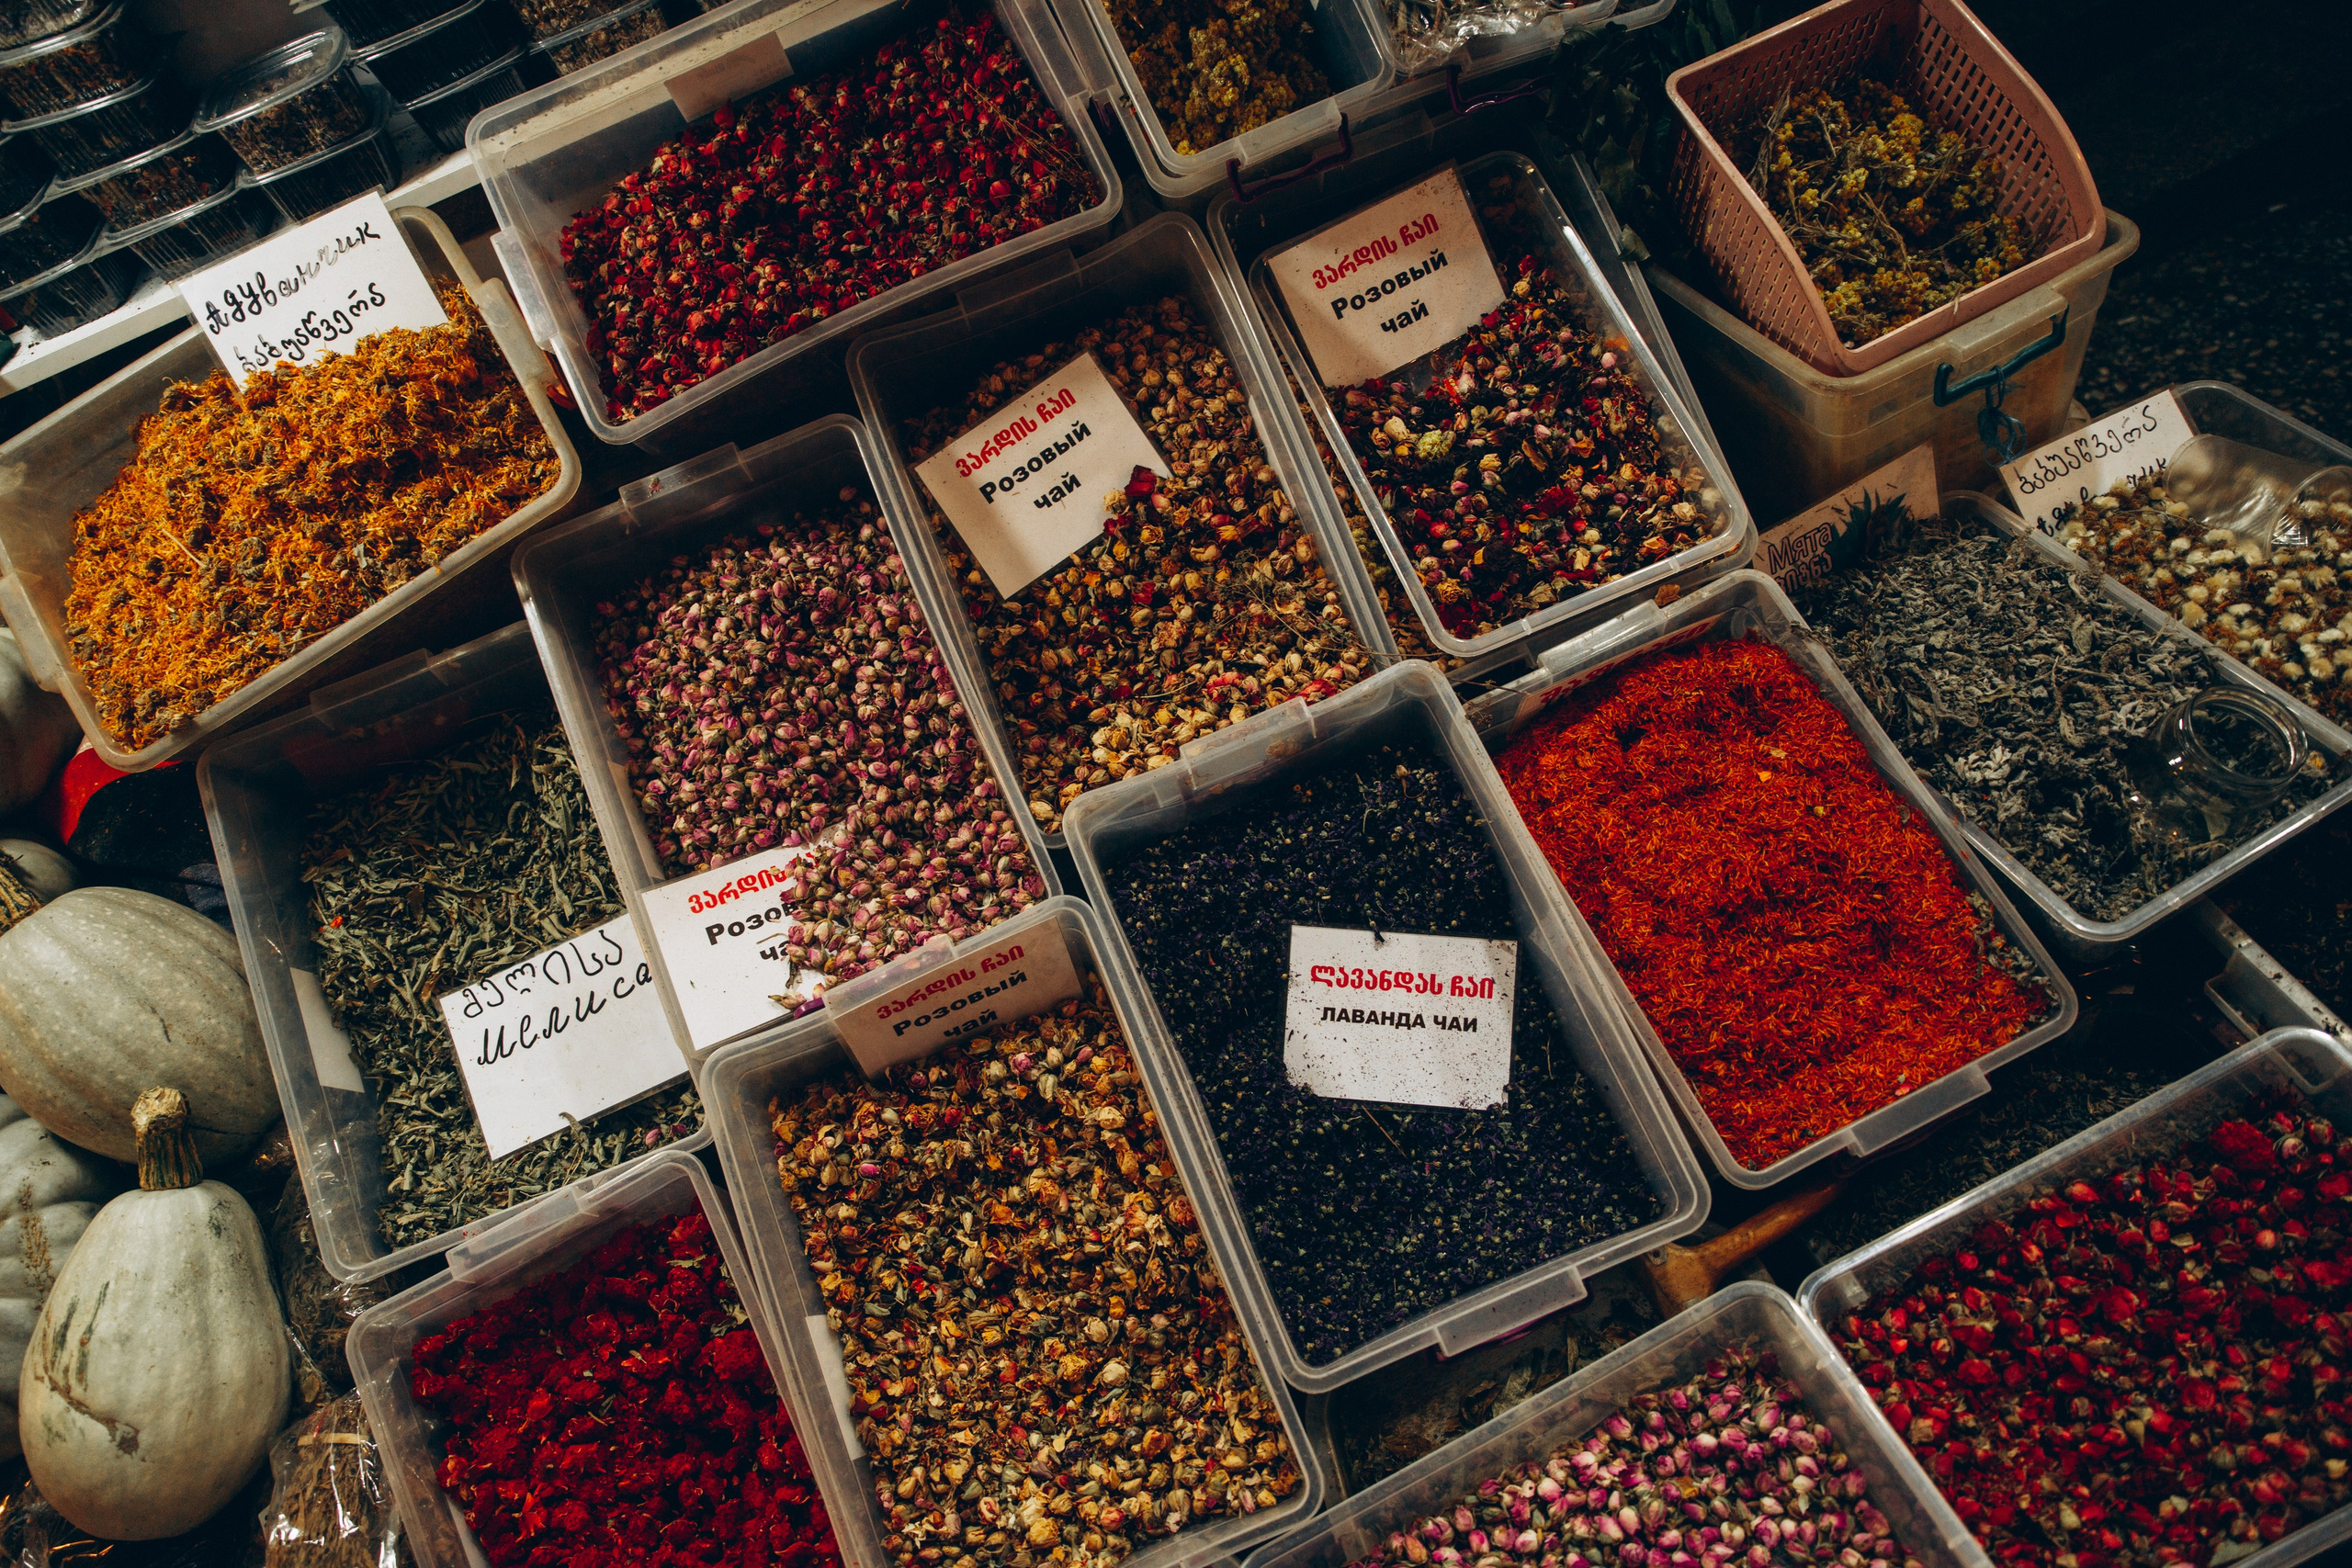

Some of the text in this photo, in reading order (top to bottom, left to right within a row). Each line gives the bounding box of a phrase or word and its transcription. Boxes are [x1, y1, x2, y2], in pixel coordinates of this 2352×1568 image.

[1312, 213, 1440, 289] ვარდის ჩაი
[1330, 248, 1448, 320] Розовый
[1380, 299, 1430, 333] чай
[956, 388, 1077, 478] ვარდის ჩაი
[978, 420, 1091, 504] Розовый
[1034, 471, 1081, 509] чай
[1768, 522, 1833, 575] Мята
[705, 901, 798, 946] Розов
[876, 944, 1024, 1020] ვარდის ჩაი
[892, 969, 1027, 1036] Розовый
[1310, 964, 1495, 999] ლავანდას ჩაი
[943, 1009, 998, 1038] чай
[1320, 1006, 1477, 1032] ЛАВАНДА ЧАИ
